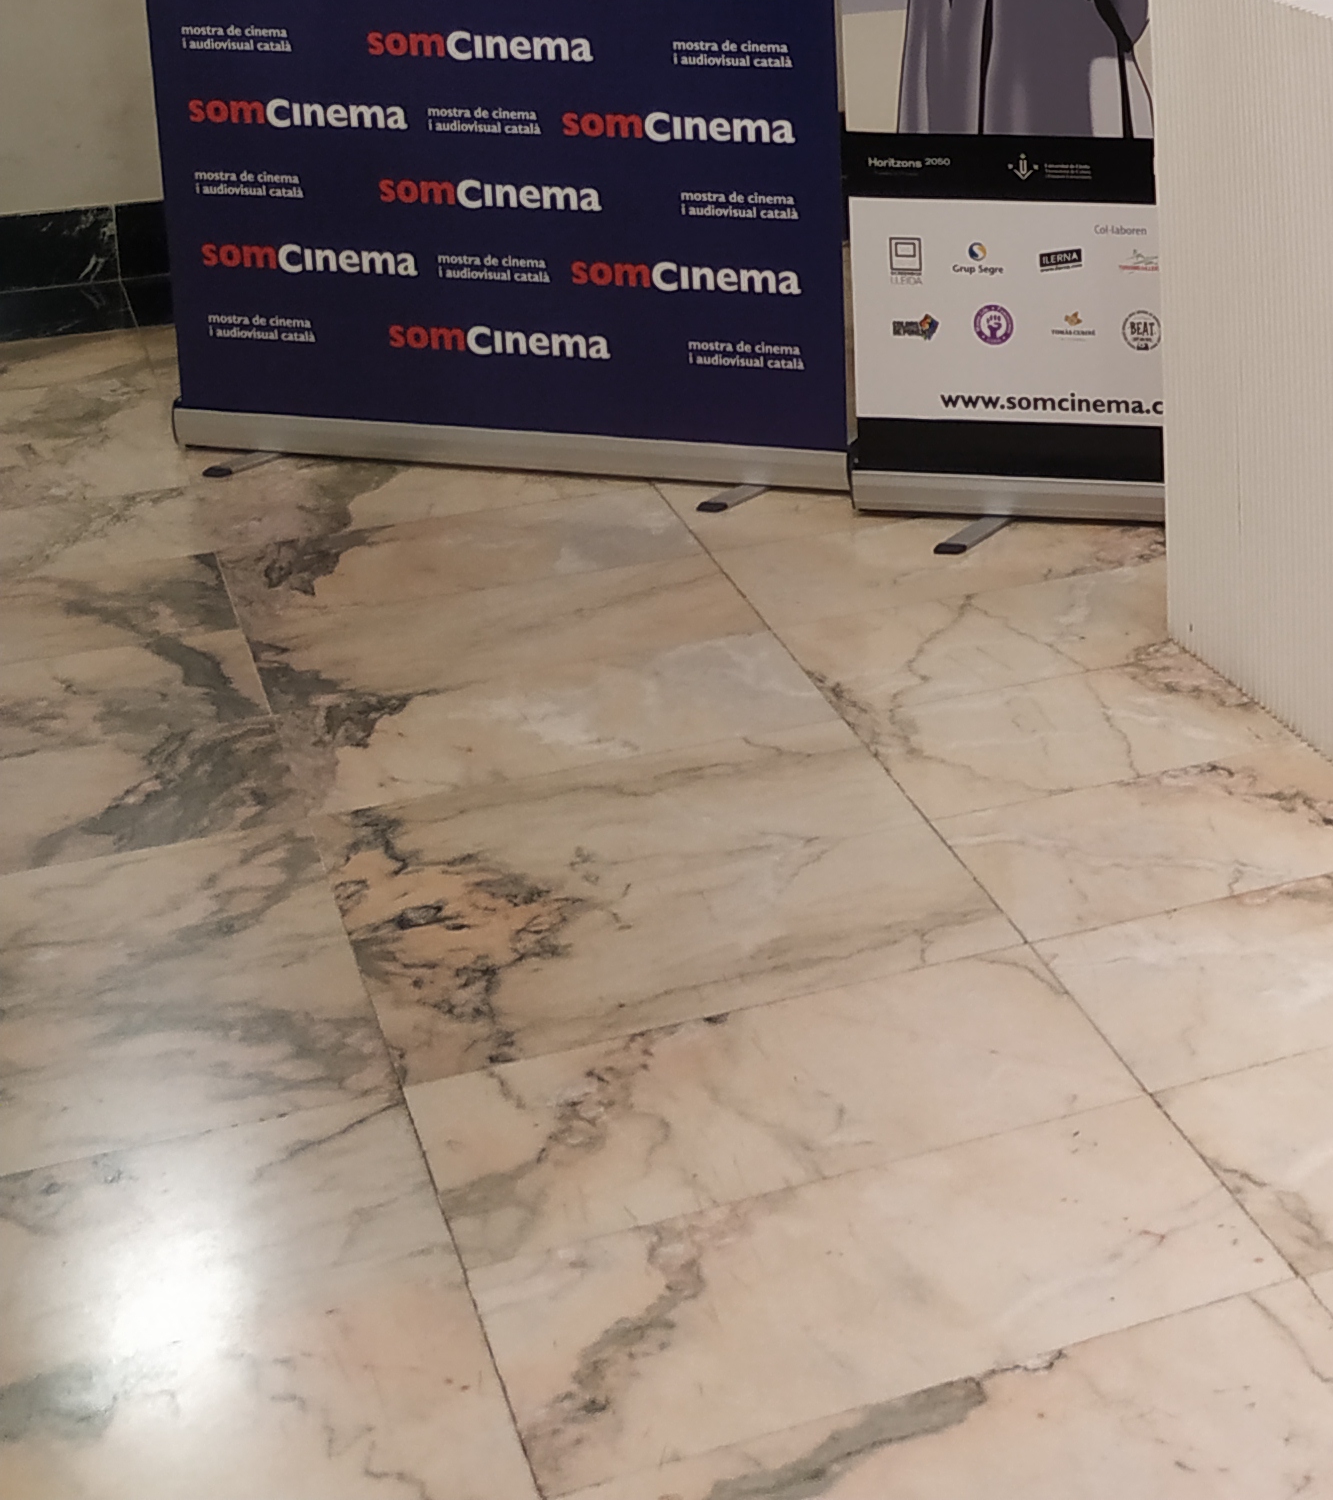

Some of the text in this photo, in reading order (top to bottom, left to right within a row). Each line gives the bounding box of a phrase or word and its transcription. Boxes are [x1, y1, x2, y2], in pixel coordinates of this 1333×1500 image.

[180, 23, 287, 38] mostra de cinema
[181, 36, 292, 52] i audiovisual català
[365, 29, 594, 62] somCinema
[671, 39, 789, 53] mostra de cinema
[672, 51, 793, 68] i audiovisual català
[187, 97, 408, 130] somCinema
[560, 110, 796, 144] somCinema
[868, 157, 922, 168] Horitzons
[377, 177, 602, 212] somCinema
[679, 190, 794, 205] mostra de cinema
[680, 202, 799, 220] i audiovisual català
[200, 242, 418, 276] somCinema
[436, 253, 546, 269] mostra de cinema
[1042, 252, 1079, 264] ILERNA
[437, 265, 550, 283] i audiovisual català
[570, 259, 802, 295] somCinema
[952, 264, 1004, 275] Grup Segre
[207, 313, 311, 328] mostra de cinema
[1130, 321, 1155, 336] BEAT
[208, 324, 315, 342] i audiovisual català
[387, 323, 611, 359] somCinema
[687, 339, 800, 356] mostra de cinema
[687, 351, 804, 370] i audiovisual català
